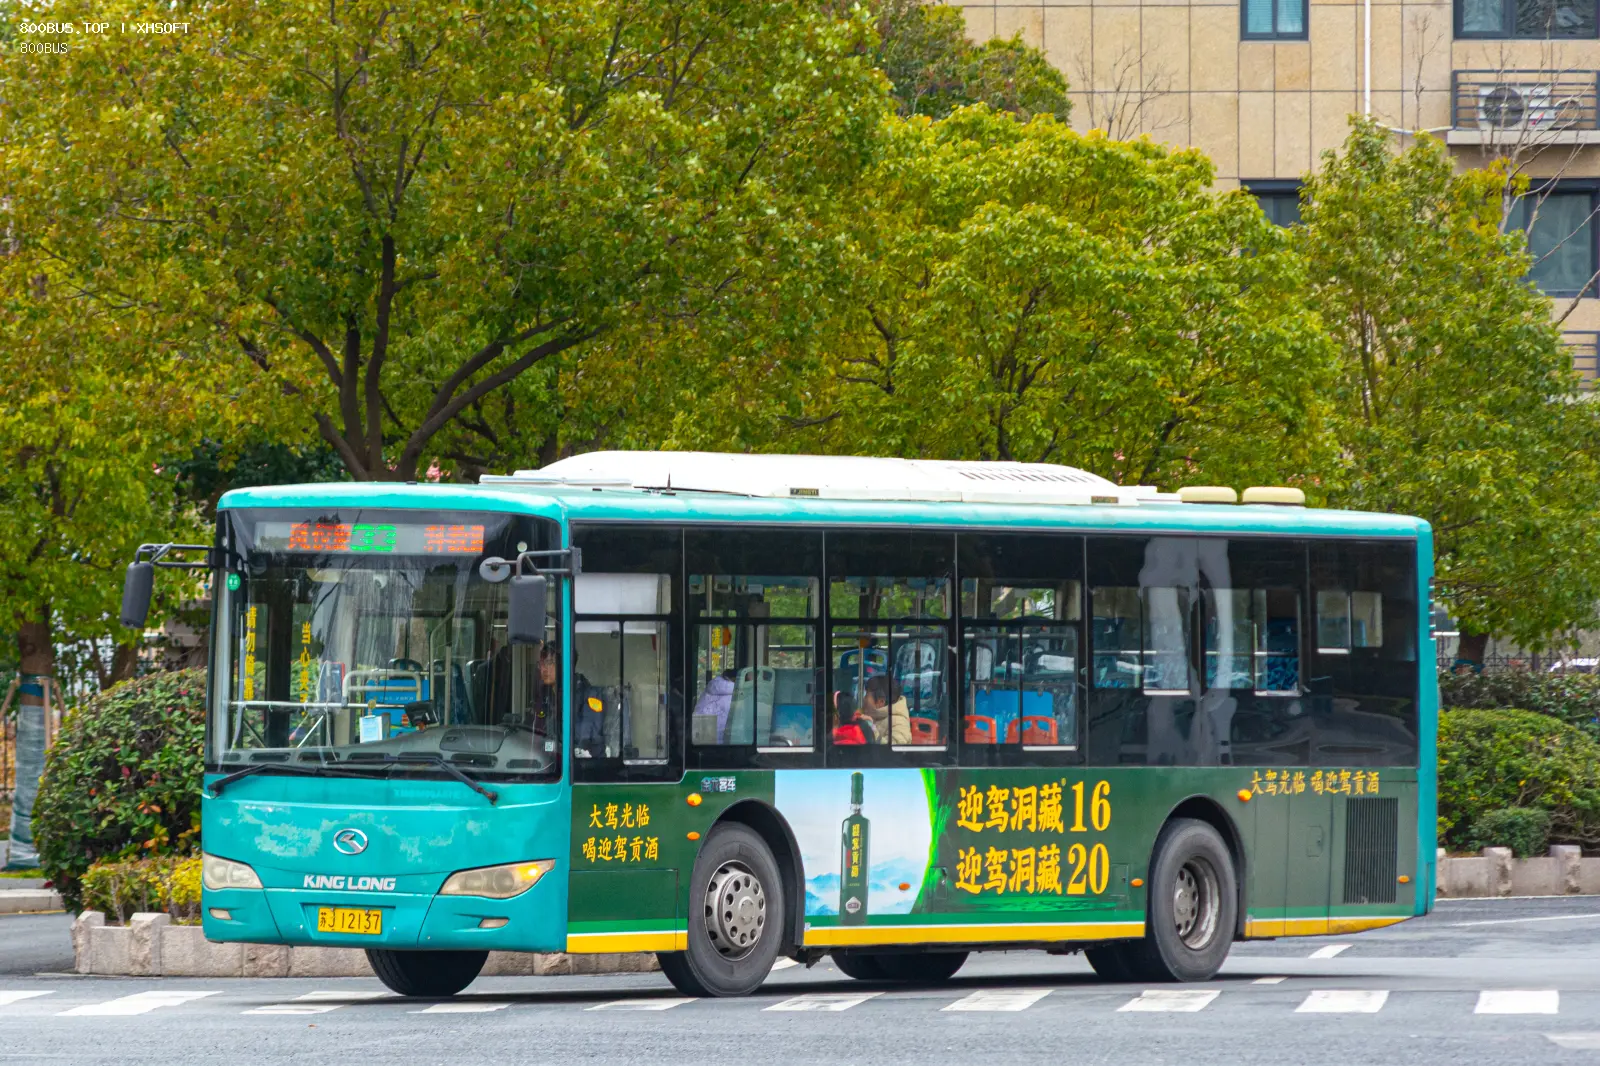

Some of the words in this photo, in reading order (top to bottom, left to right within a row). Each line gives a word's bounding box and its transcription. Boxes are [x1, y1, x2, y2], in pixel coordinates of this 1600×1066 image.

[589, 802, 650, 830] 大驾光临
[582, 834, 659, 863] 喝迎驾贡酒
[303, 875, 345, 889] KING
[347, 877, 396, 891] LONG
